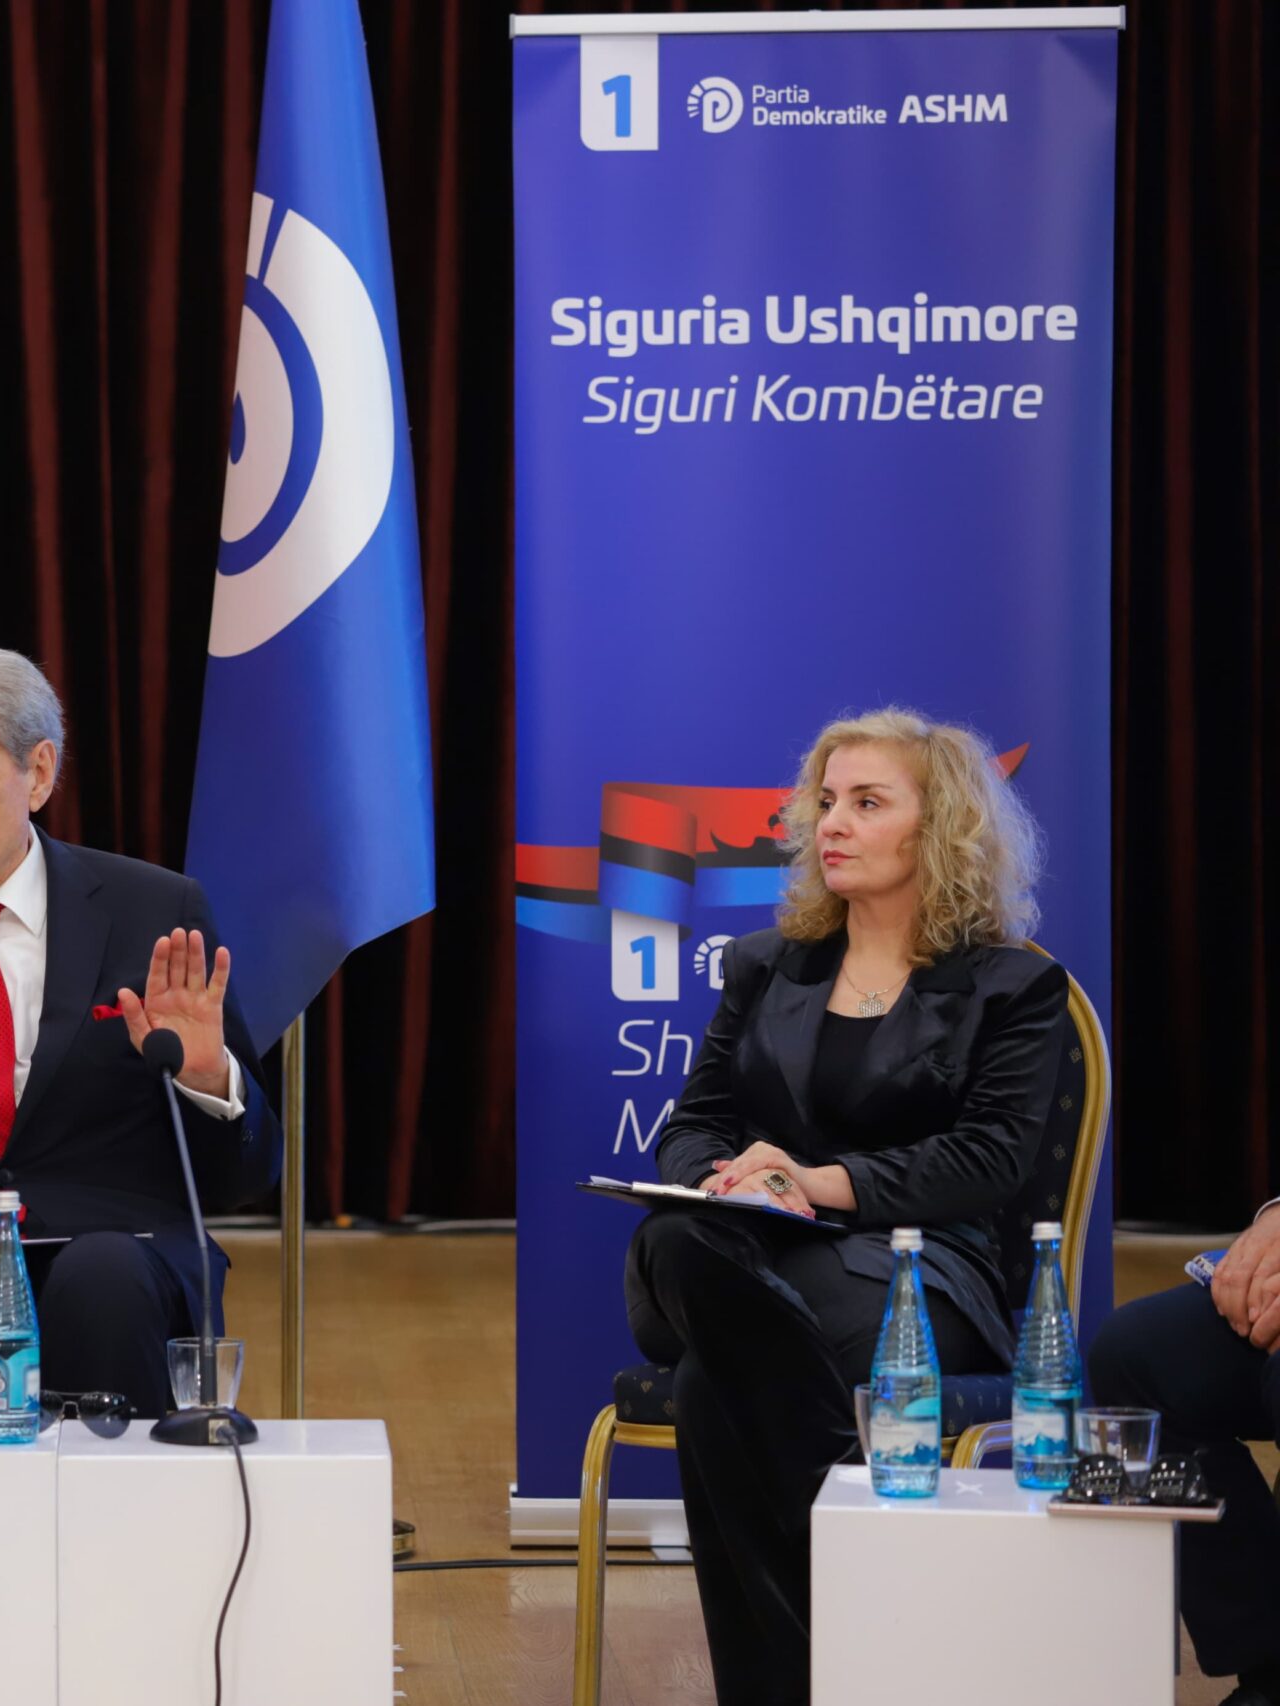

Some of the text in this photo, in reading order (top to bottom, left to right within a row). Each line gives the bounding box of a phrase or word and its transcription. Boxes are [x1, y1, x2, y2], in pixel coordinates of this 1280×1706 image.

[601, 74, 632, 138] 1
[752, 84, 810, 104] Partia
[752, 105, 887, 126] Demokratike
[898, 93, 1008, 124] ASHM
[550, 292, 1078, 358] Siguria Ushqimore
[582, 373, 1043, 435] Siguri Kombëtare
[629, 935, 656, 990] 1
